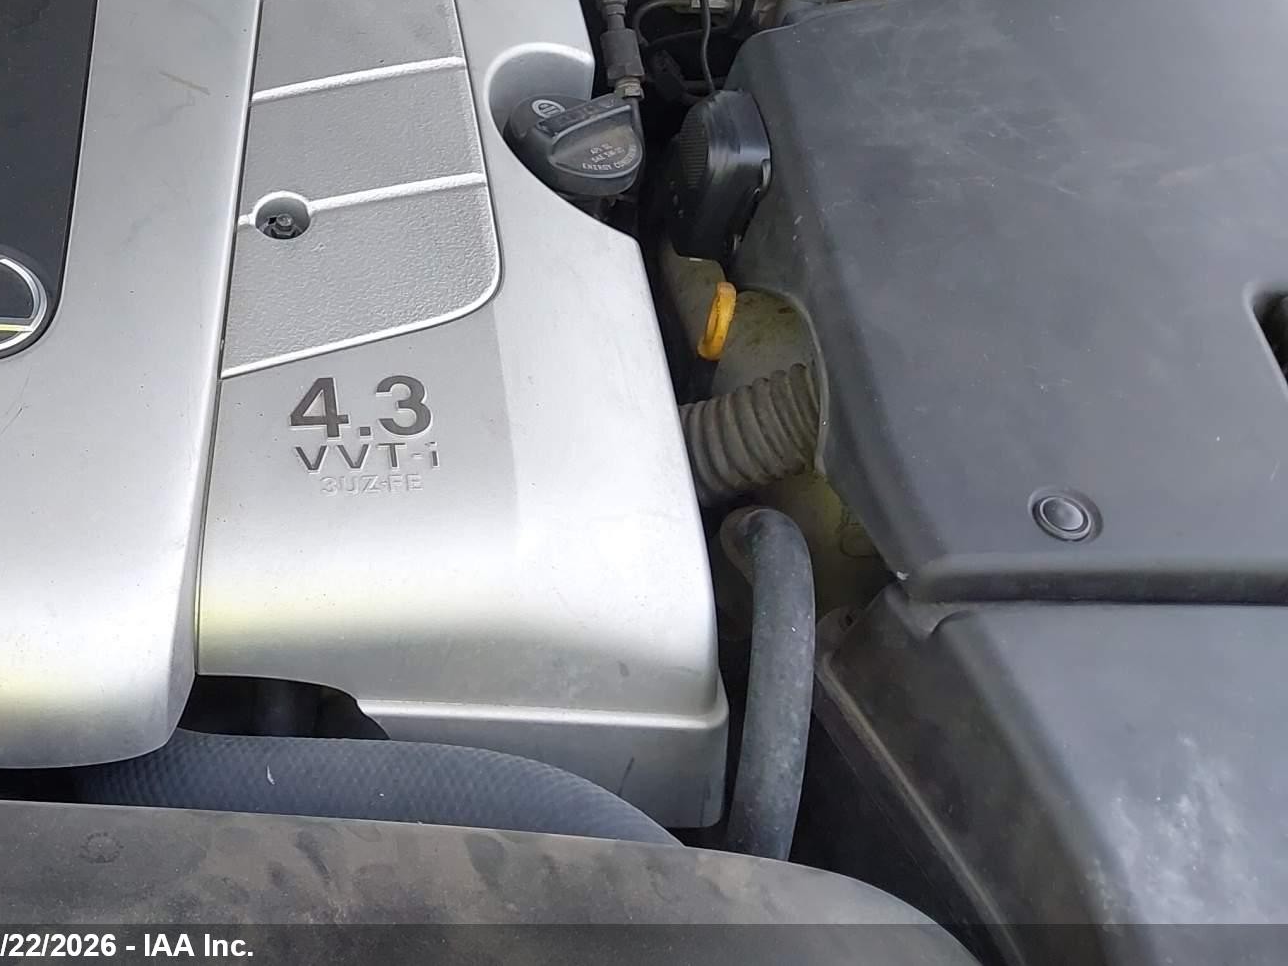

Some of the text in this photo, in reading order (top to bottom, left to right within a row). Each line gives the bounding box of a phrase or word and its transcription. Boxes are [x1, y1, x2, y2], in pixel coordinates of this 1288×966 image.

[289, 375, 433, 440] 4.3
[295, 442, 440, 474] VVT-i
[320, 474, 425, 497] 3UZ-FE
